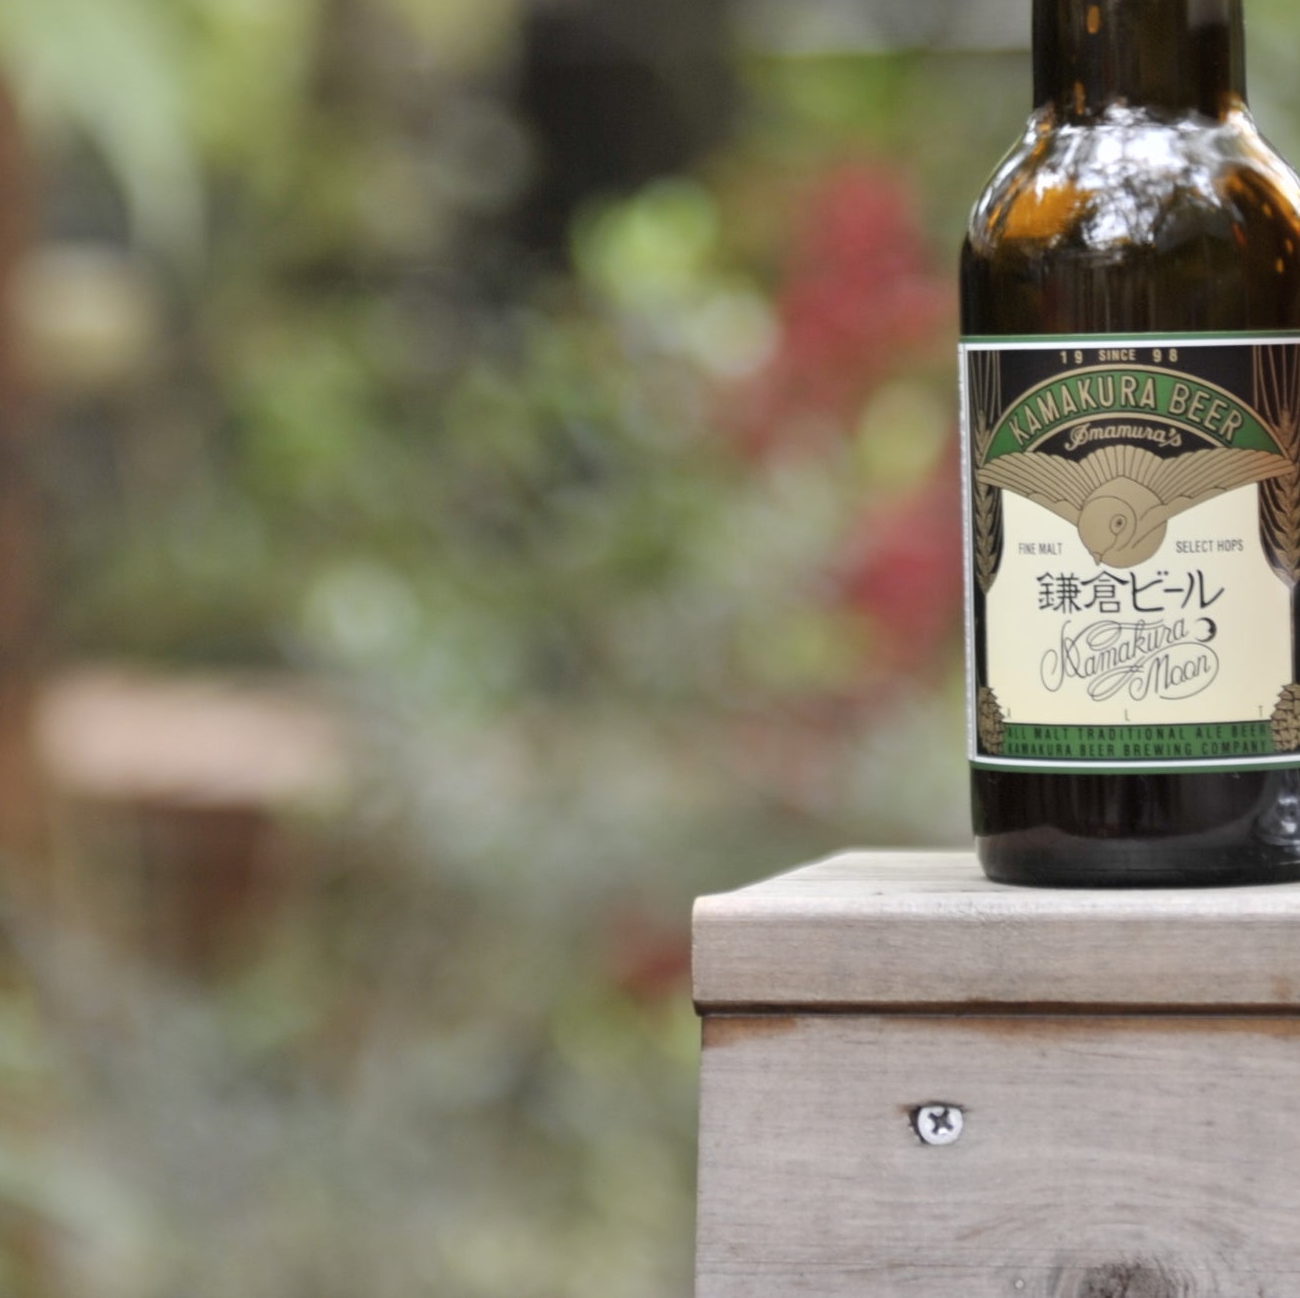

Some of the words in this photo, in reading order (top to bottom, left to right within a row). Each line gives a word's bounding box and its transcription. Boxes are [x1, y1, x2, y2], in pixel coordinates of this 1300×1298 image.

[1099, 349, 1136, 361] SINCE
[1009, 374, 1156, 445] KAMAKURA
[1168, 385, 1244, 442] BEER
[1018, 541, 1036, 556] FINE
[1039, 541, 1063, 555] MALT
[1175, 541, 1214, 553] SELECT
[1217, 539, 1243, 553] HOPS
[1035, 568, 1224, 614] 鎌倉ビール
[1040, 619, 1189, 692] Kamakura
[1007, 727, 1028, 740] ALL
[1034, 727, 1069, 741] MALT
[1076, 726, 1187, 741] TRADITIONAL
[1196, 725, 1225, 739] ALE
[1231, 724, 1267, 738] BEER
[1007, 741, 1073, 757] KAMAKURA
[1079, 741, 1116, 757] BEER
[1123, 740, 1194, 757] BREWING
[1201, 738, 1268, 755] COMPANY
